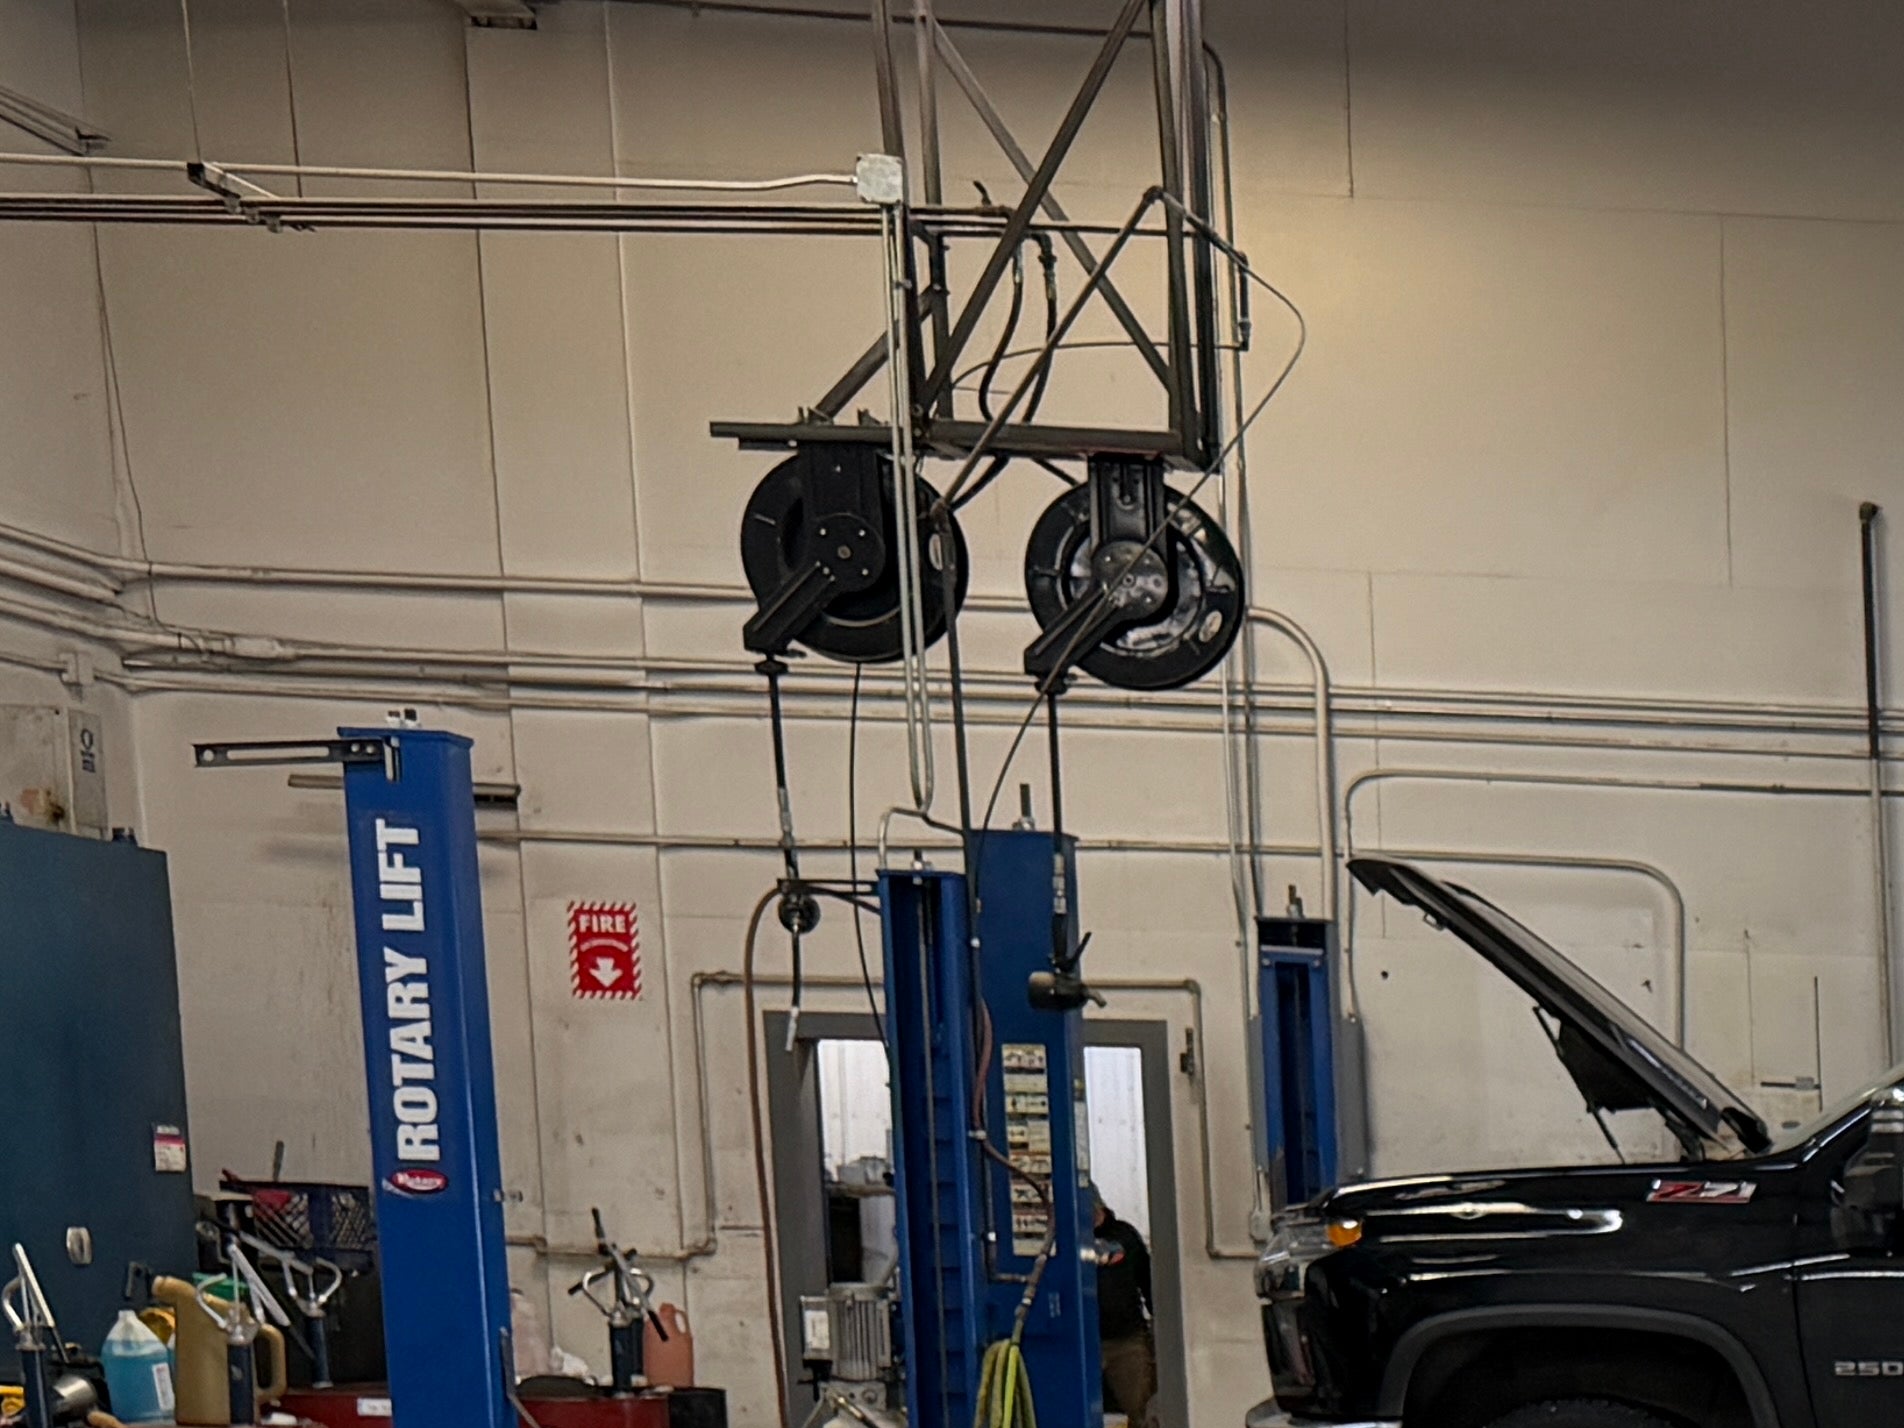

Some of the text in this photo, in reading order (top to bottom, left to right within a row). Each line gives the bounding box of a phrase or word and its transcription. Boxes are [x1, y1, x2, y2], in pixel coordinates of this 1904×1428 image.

[375, 818, 441, 1162] ROTARY LIFT
[579, 914, 627, 933] FIRE
